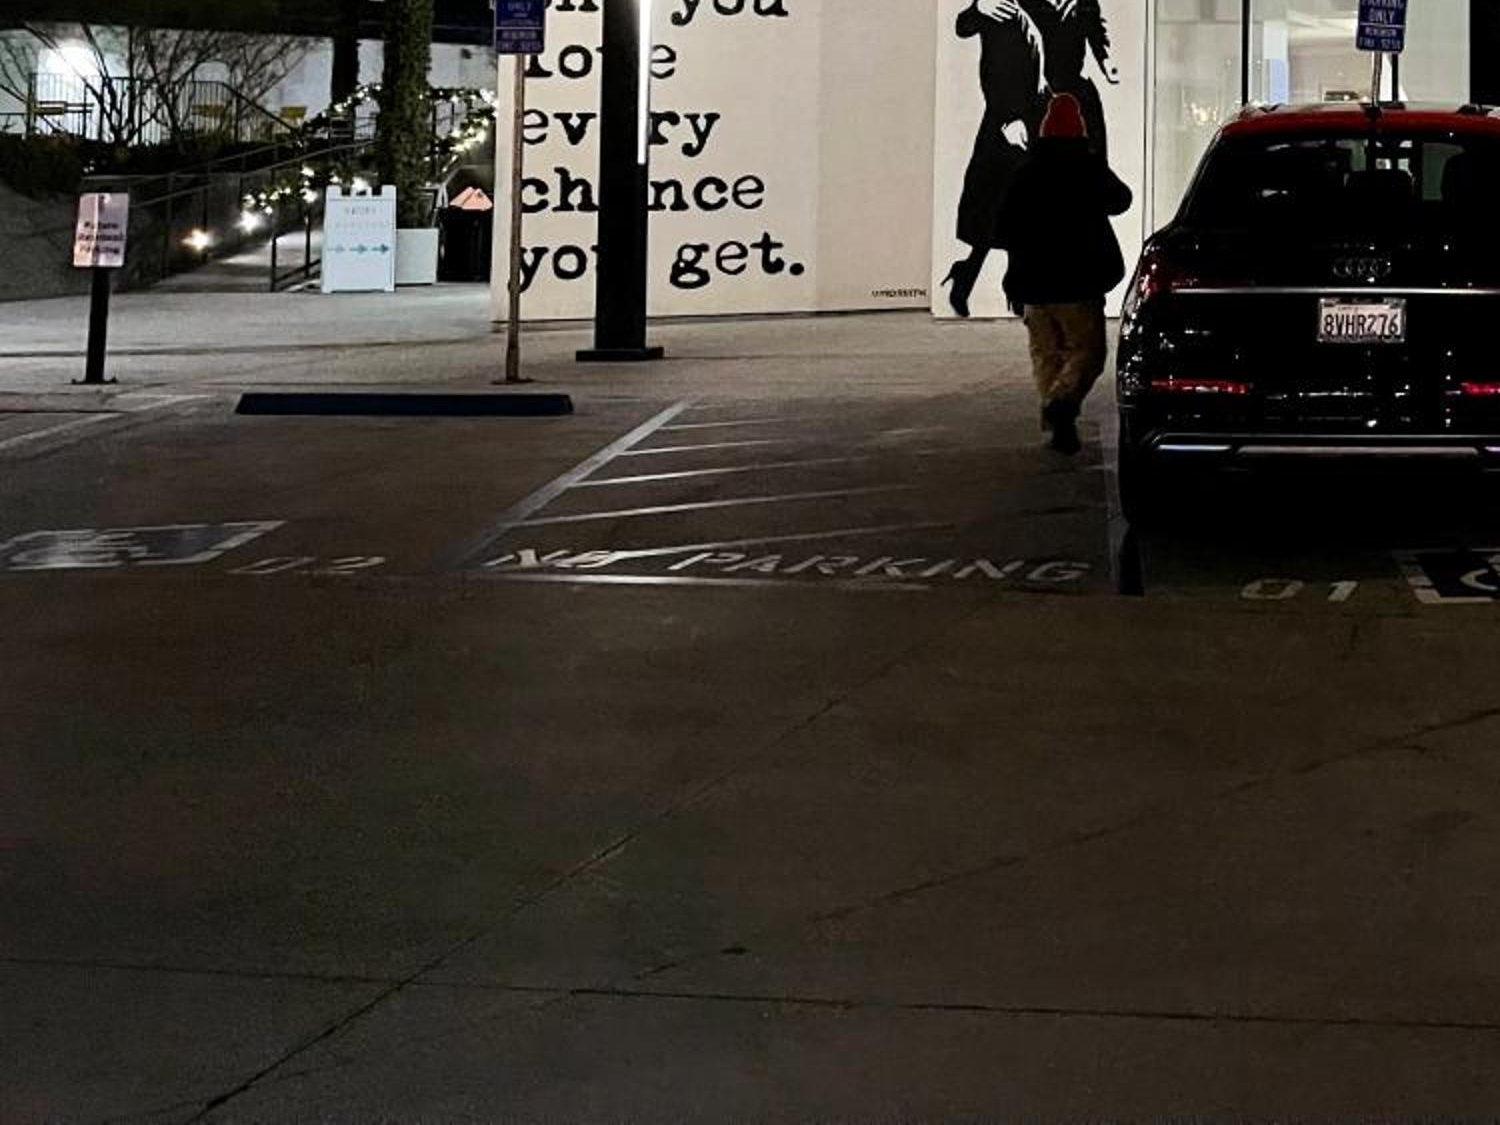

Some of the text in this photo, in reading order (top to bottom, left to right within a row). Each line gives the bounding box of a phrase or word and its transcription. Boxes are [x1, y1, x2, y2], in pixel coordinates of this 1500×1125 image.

[1369, 8, 1396, 24] ONLY
[521, 108, 721, 157] evry
[520, 166, 766, 213] chnce
[508, 231, 805, 293] yo get.
[1324, 313, 1400, 336] 8VHR276
[667, 552, 1092, 581] PARKING
[1240, 578, 1359, 602] 01
